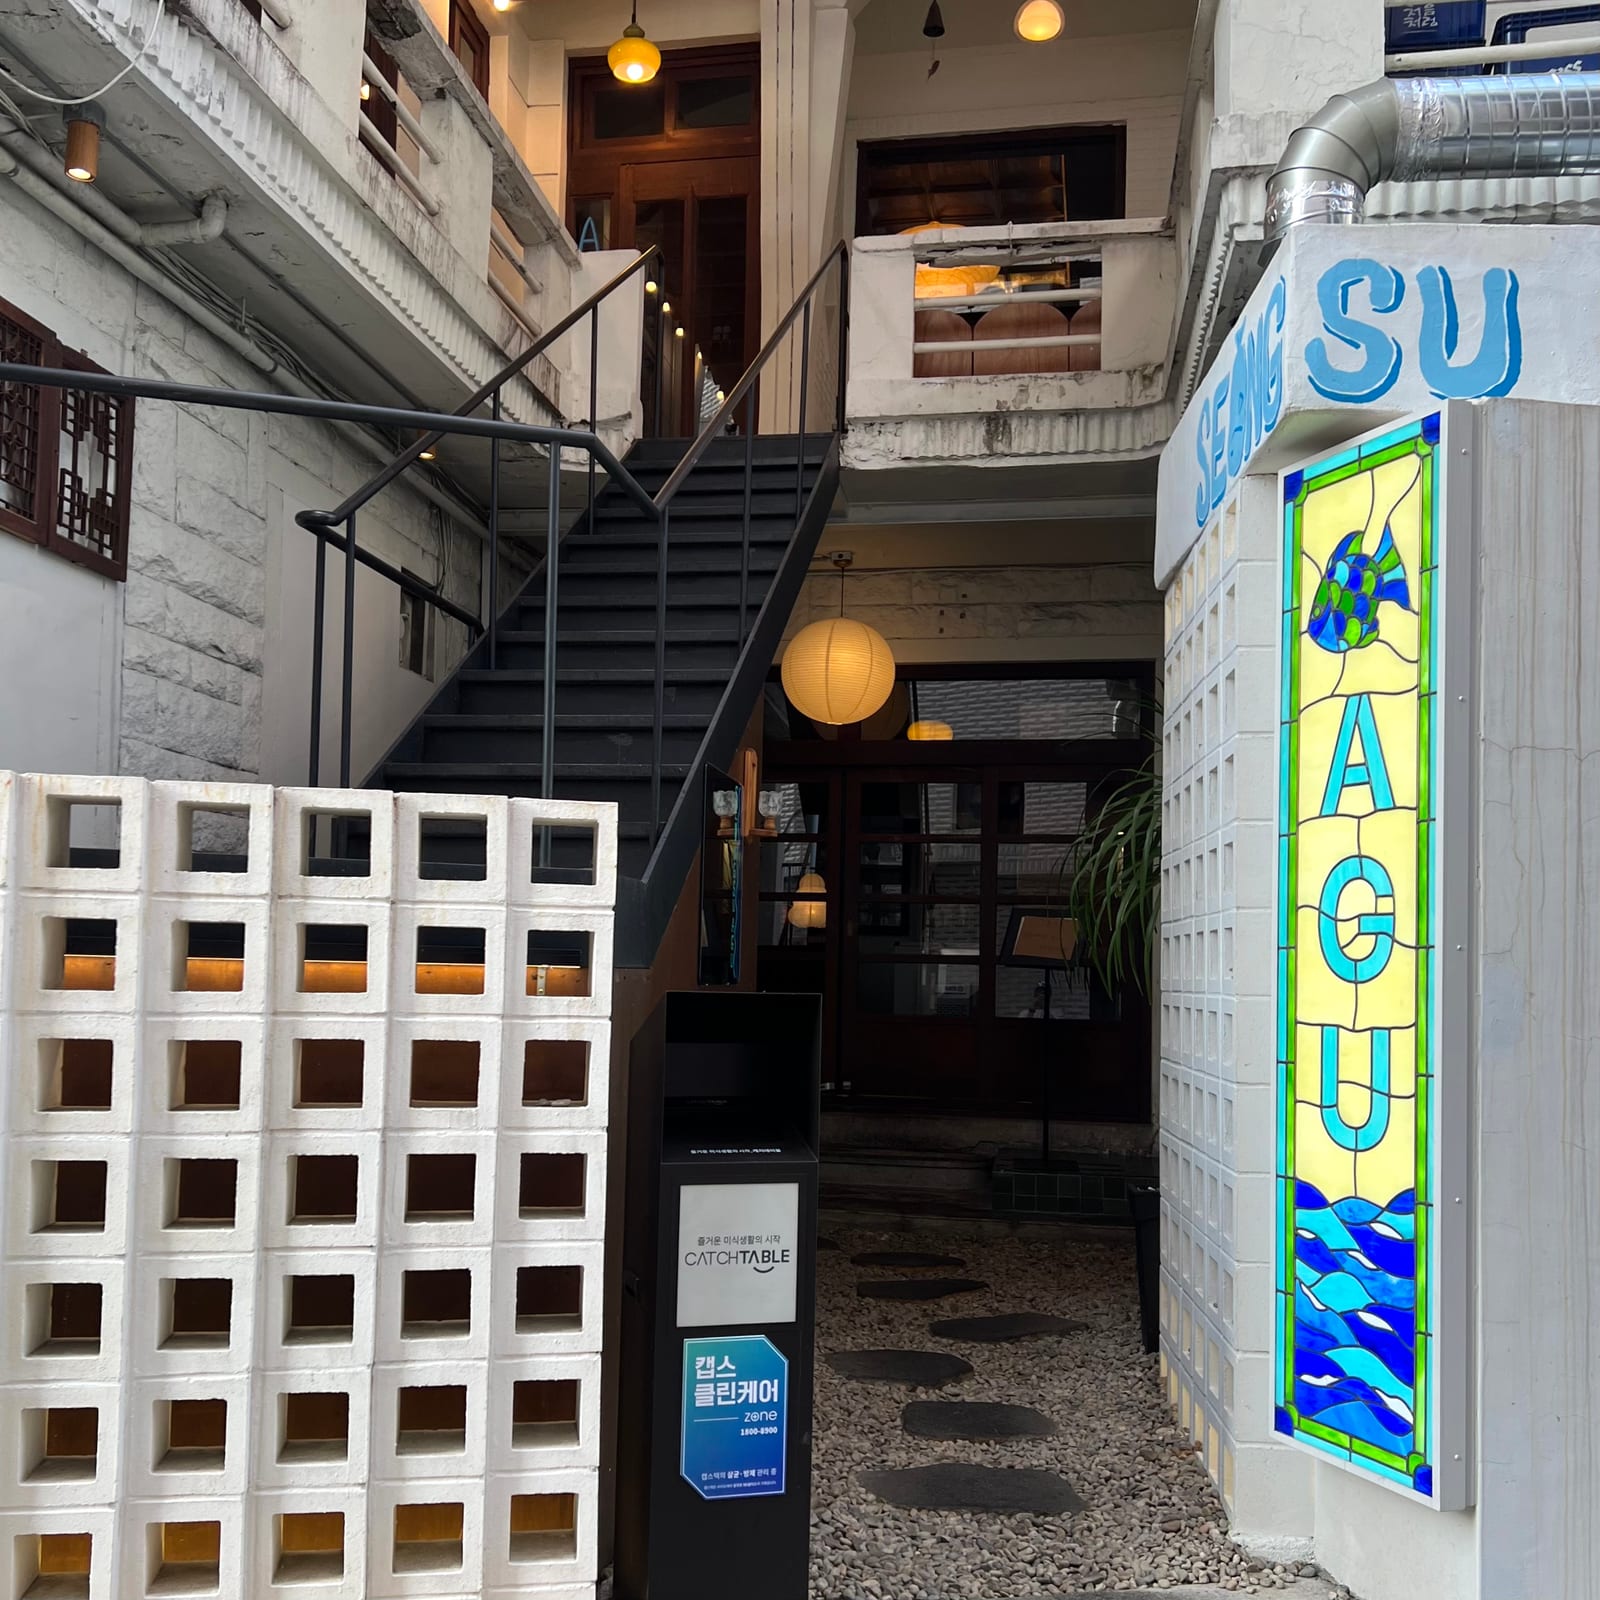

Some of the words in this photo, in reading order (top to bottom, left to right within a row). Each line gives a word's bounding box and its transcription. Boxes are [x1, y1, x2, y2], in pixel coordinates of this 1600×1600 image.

[1196, 275, 1286, 527] SEONG
[1304, 258, 1522, 403] SU
[1318, 693, 1396, 1152] AGU
[698, 1236, 721, 1247] 즐거운
[723, 1235, 763, 1246] 미식생활의
[765, 1234, 781, 1245] 시작
[684, 1249, 790, 1267] CATCHTABLE
[695, 1355, 737, 1380] 캡스
[694, 1379, 779, 1408] 클린케어
[744, 1411, 778, 1423] zone
